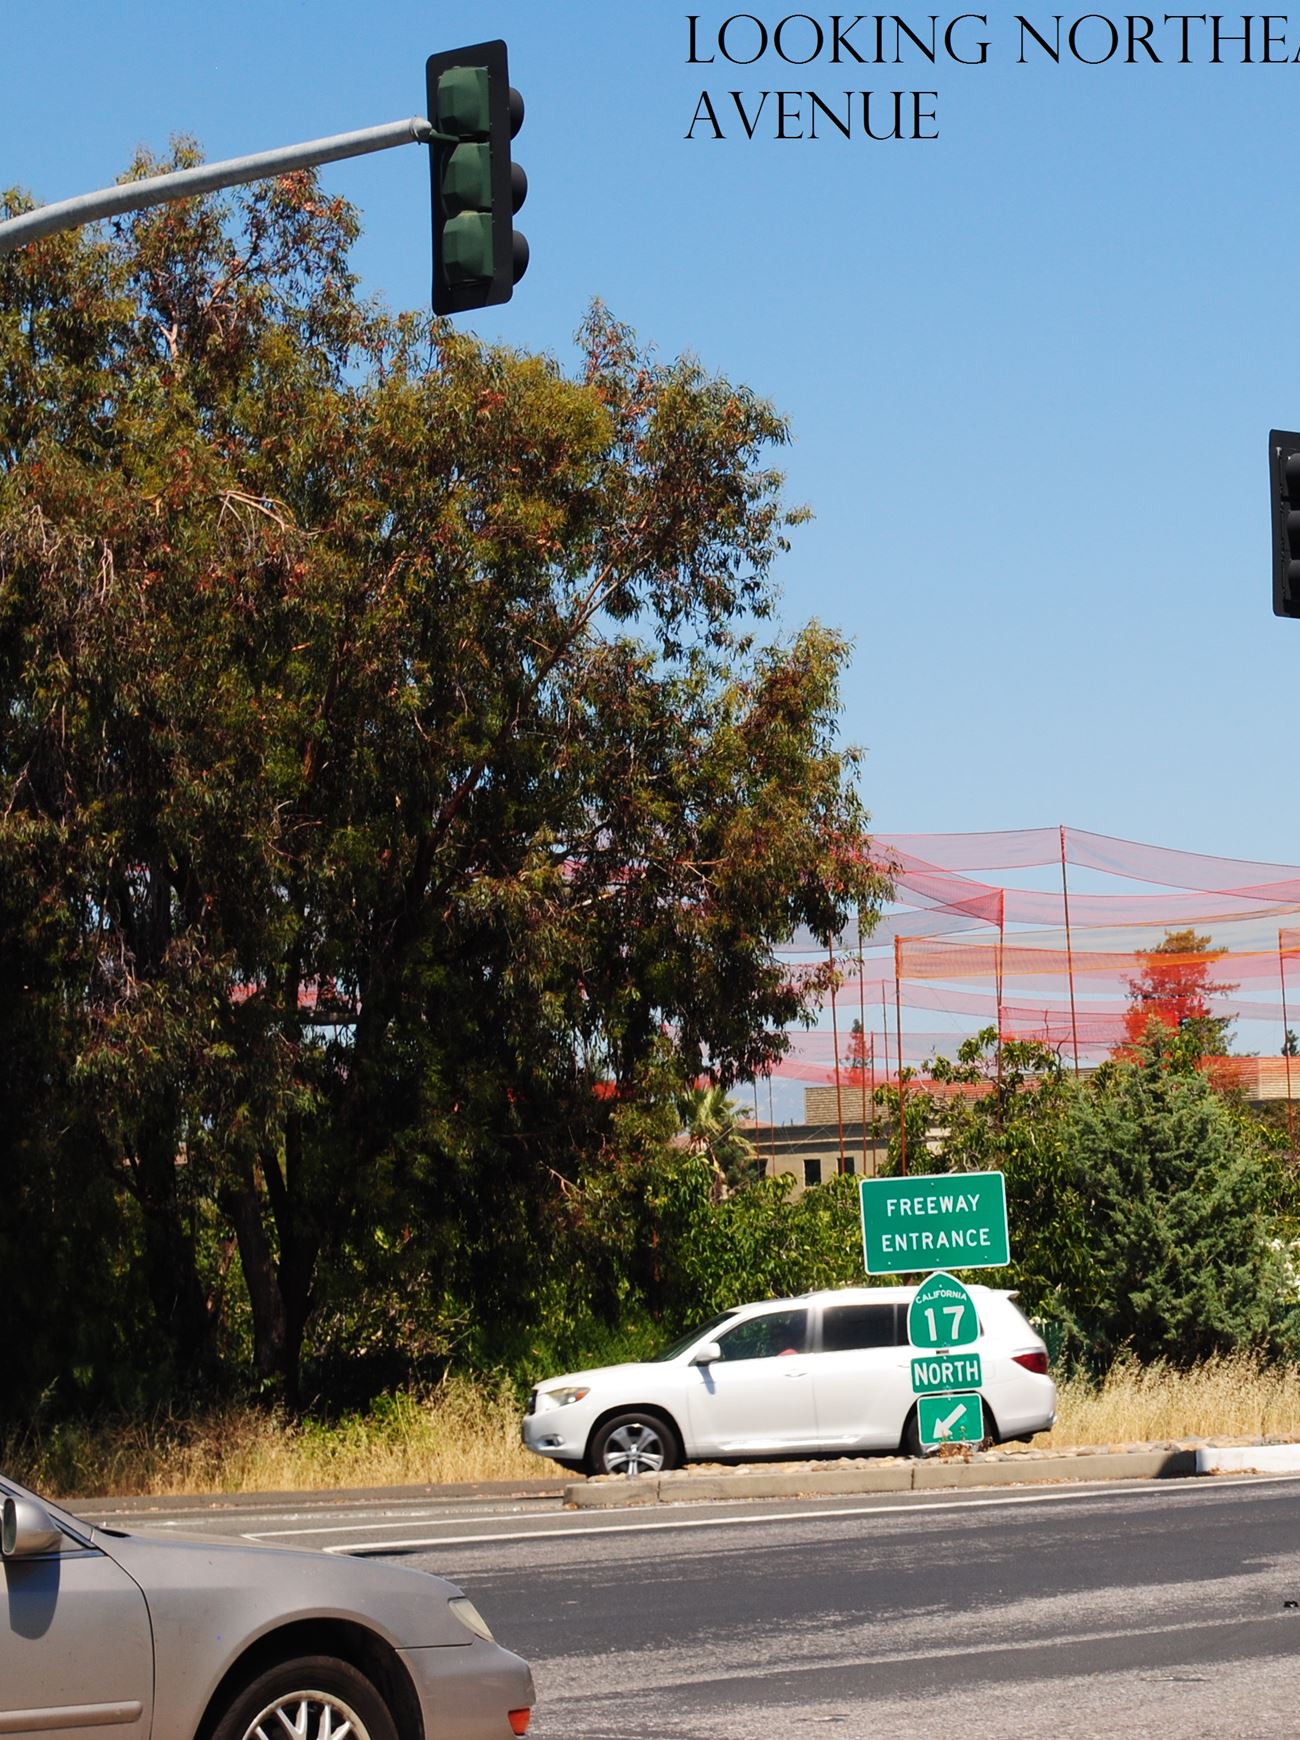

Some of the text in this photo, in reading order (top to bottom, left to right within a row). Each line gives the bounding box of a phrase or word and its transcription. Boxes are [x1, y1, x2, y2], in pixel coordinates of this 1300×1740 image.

[887, 1194, 980, 1216] FREEWAY
[882, 1228, 991, 1252] ENTRANCE
[915, 1289, 968, 1304] CALIFORNIA
[924, 1305, 965, 1341] 17
[914, 1360, 979, 1386] NORTH
